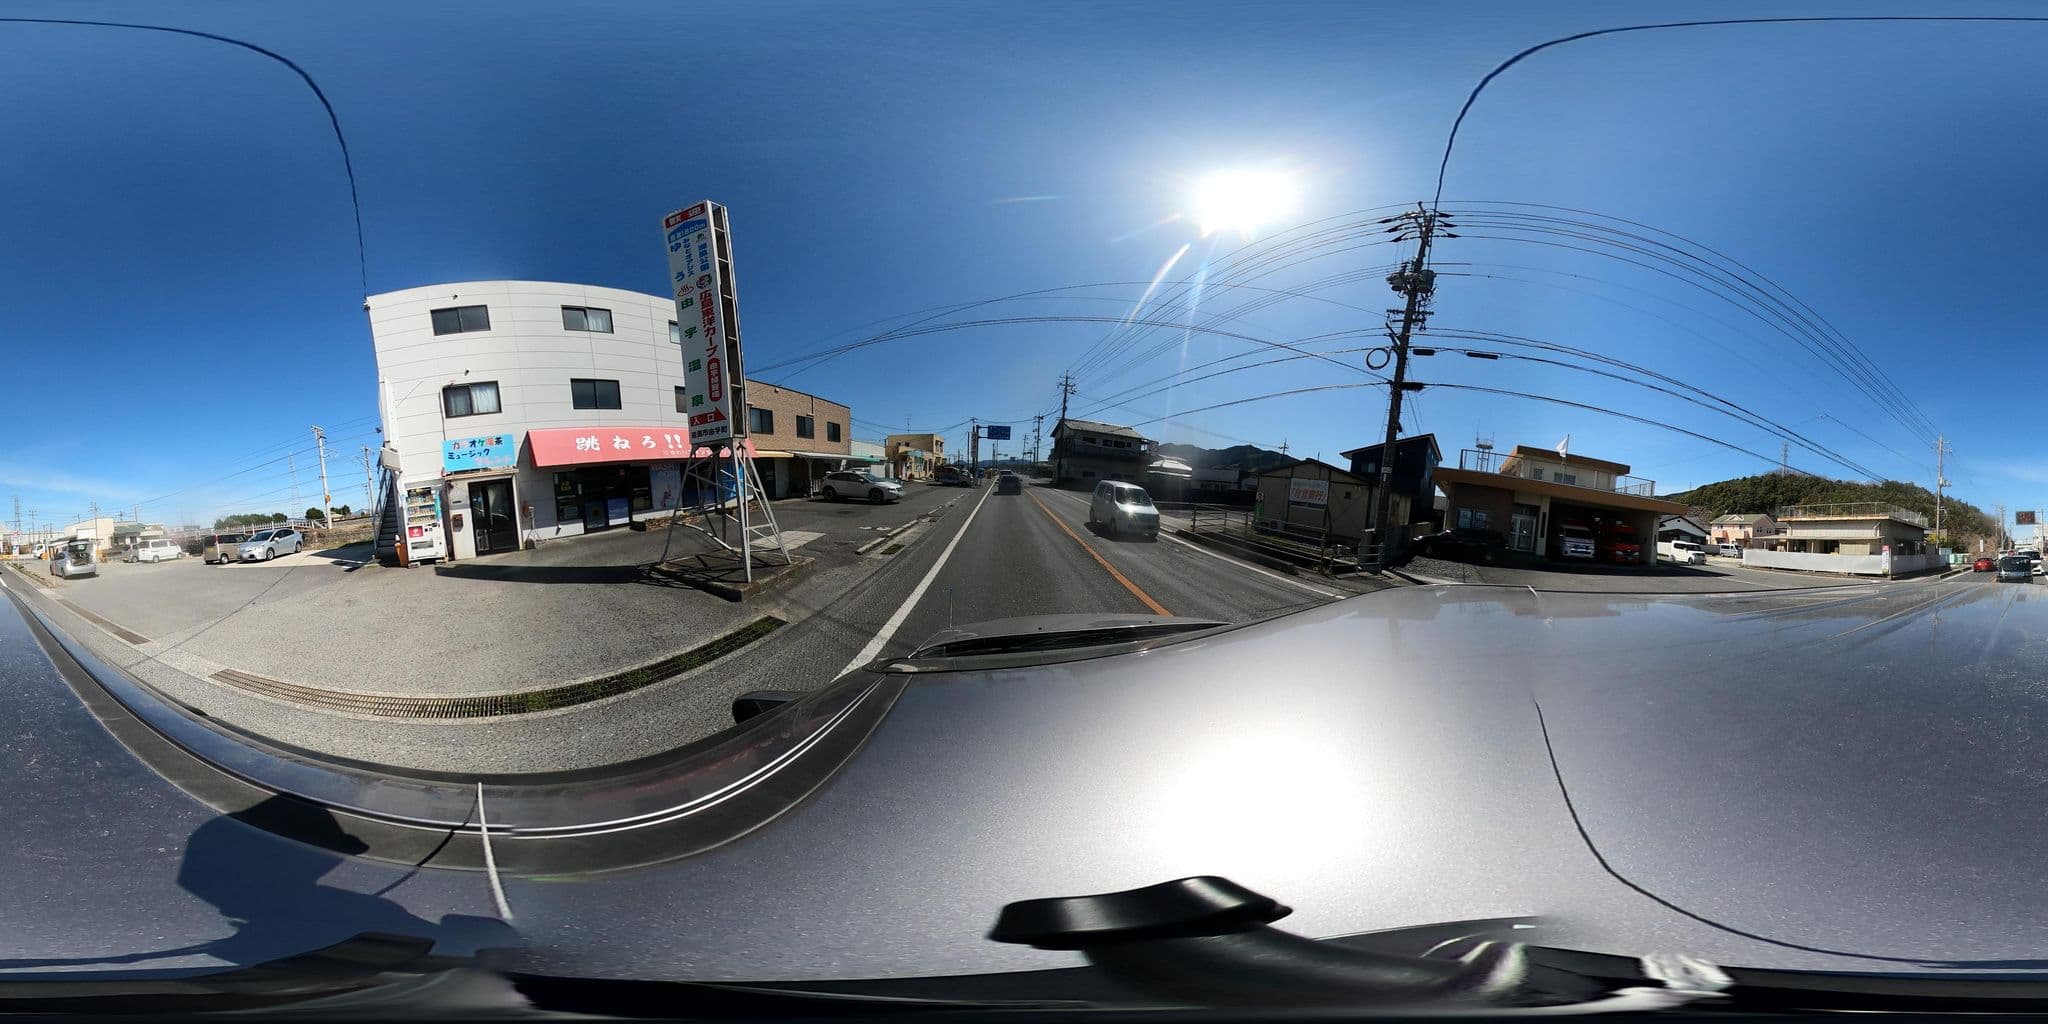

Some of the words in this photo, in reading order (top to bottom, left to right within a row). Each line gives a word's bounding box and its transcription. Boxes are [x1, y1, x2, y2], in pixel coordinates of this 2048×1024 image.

[693, 413, 715, 425] 入口
[448, 447, 490, 460] ミュージック
